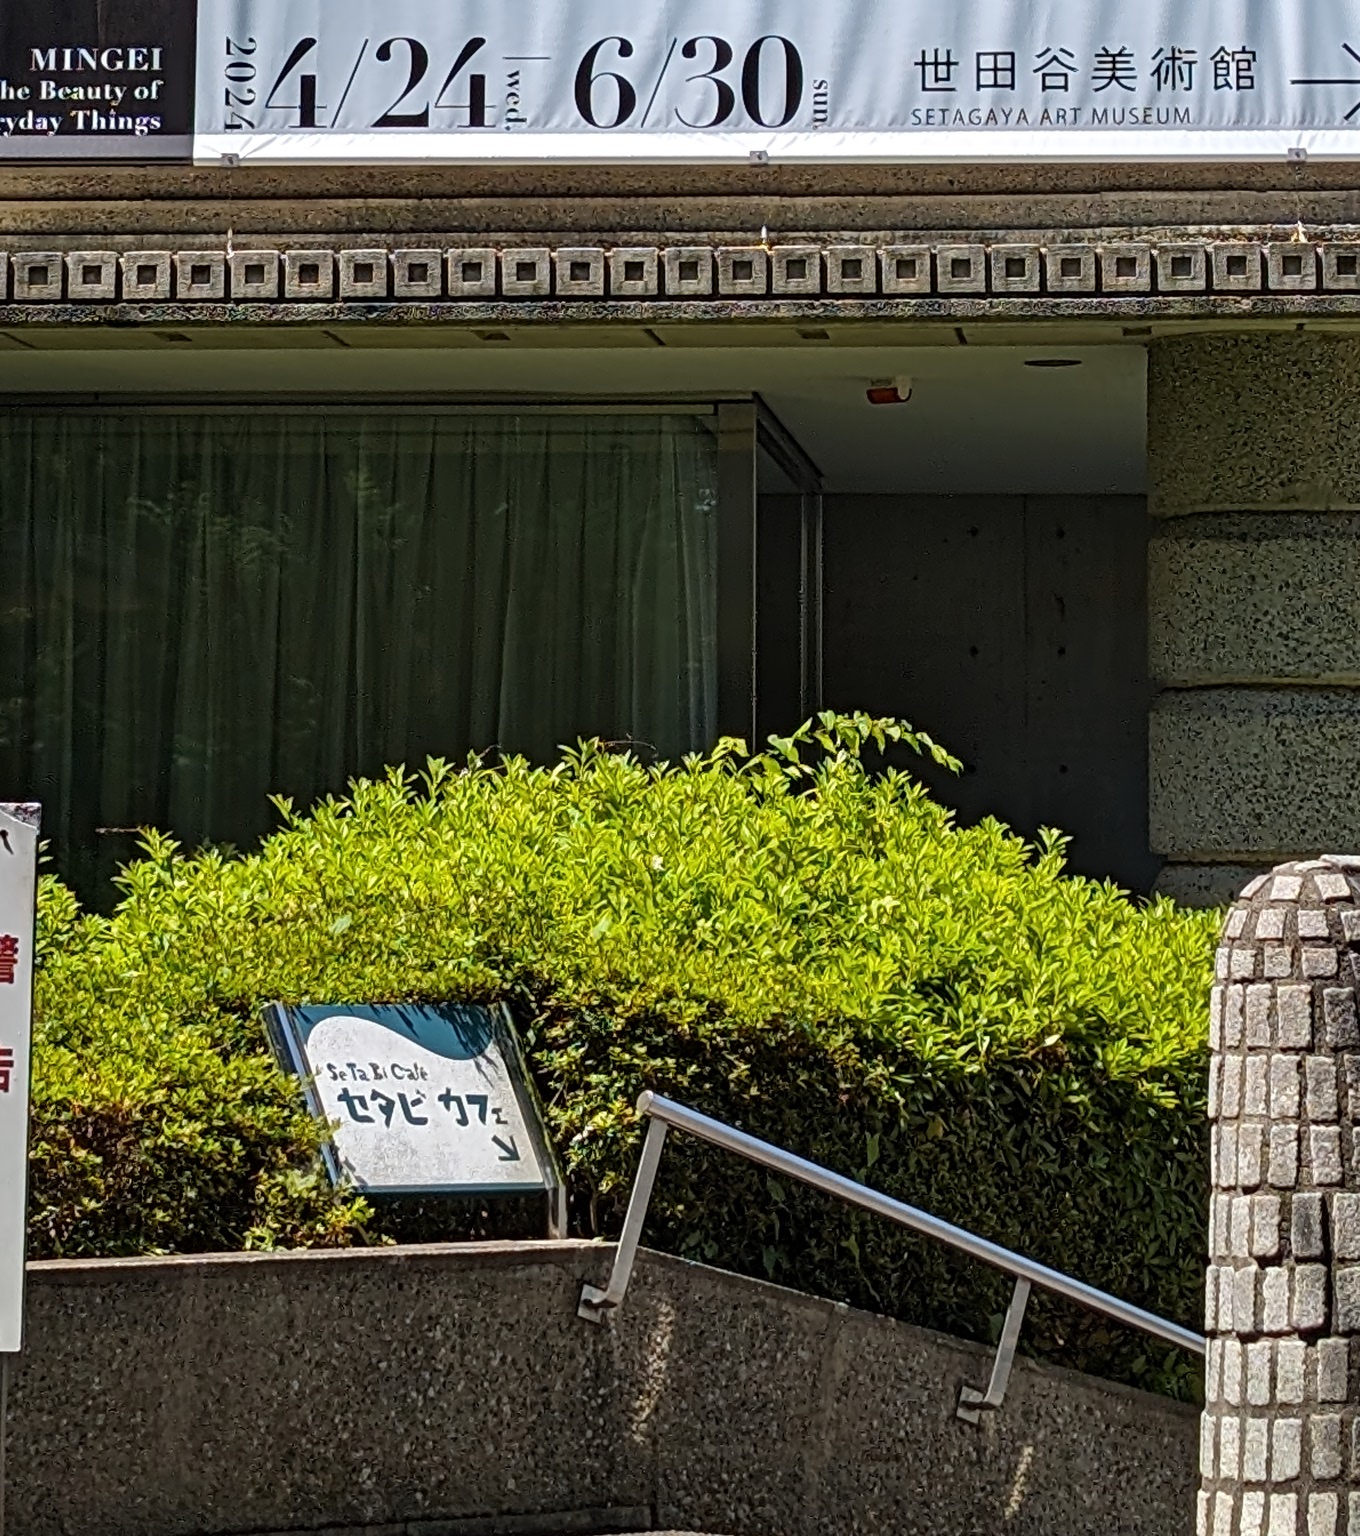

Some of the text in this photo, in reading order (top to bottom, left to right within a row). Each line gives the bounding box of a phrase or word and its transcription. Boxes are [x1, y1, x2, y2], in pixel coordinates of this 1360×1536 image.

[30, 47, 163, 71] MINGEI
[265, 36, 498, 128] 4/24
[574, 35, 803, 128] 6/30
[914, 46, 1257, 93] 世田谷美術館
[40, 80, 127, 106] Beauty
[134, 80, 164, 100] of
[224, 36, 257, 132] 2024
[504, 69, 527, 132] wed.
[811, 79, 829, 131] sun.
[70, 109, 162, 137] Things
[911, 107, 1192, 126] SETAGAYA ART MUSEUM
[337, 1087, 508, 1129] セタビ カフェ
